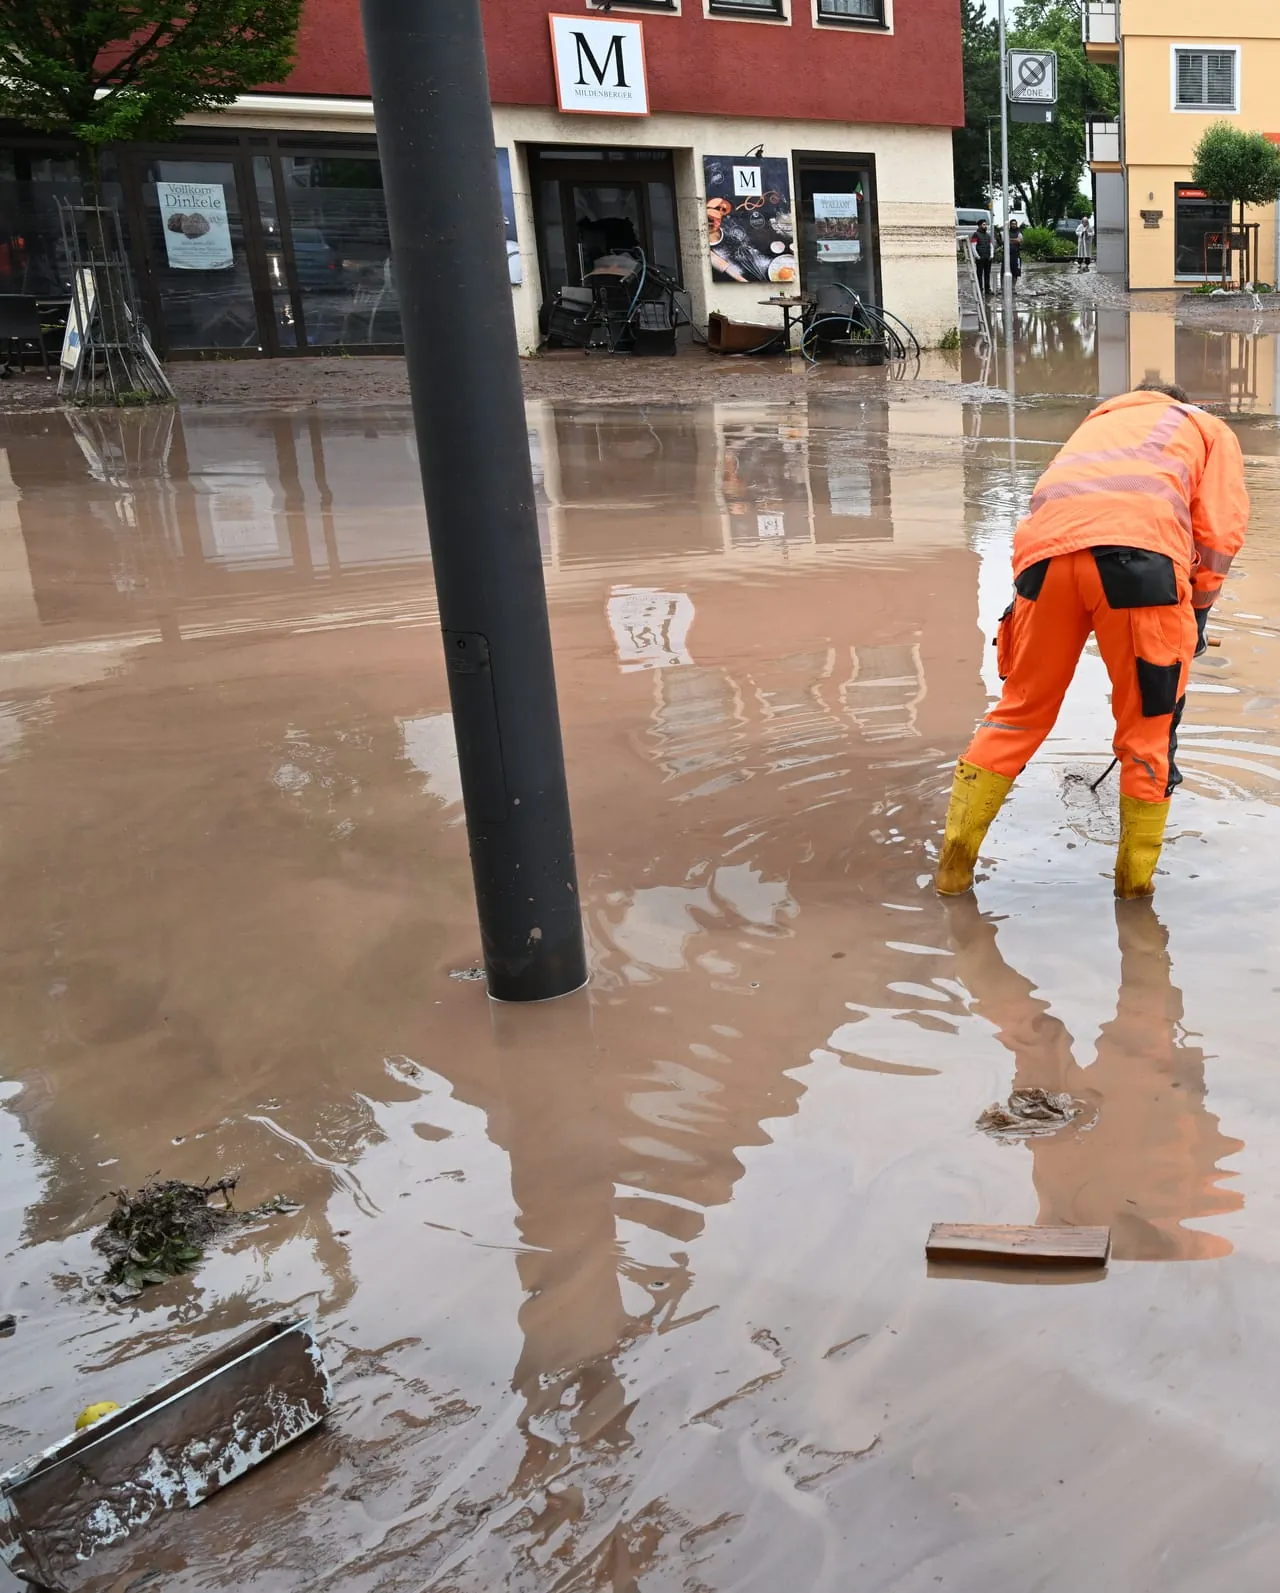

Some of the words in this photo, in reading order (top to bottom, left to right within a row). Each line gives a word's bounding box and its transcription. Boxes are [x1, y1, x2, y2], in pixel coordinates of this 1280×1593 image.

[568, 32, 631, 87] M
[574, 89, 632, 98] MILDENBERGER
[740, 171, 756, 188] M
[165, 194, 220, 208] Dinkele
